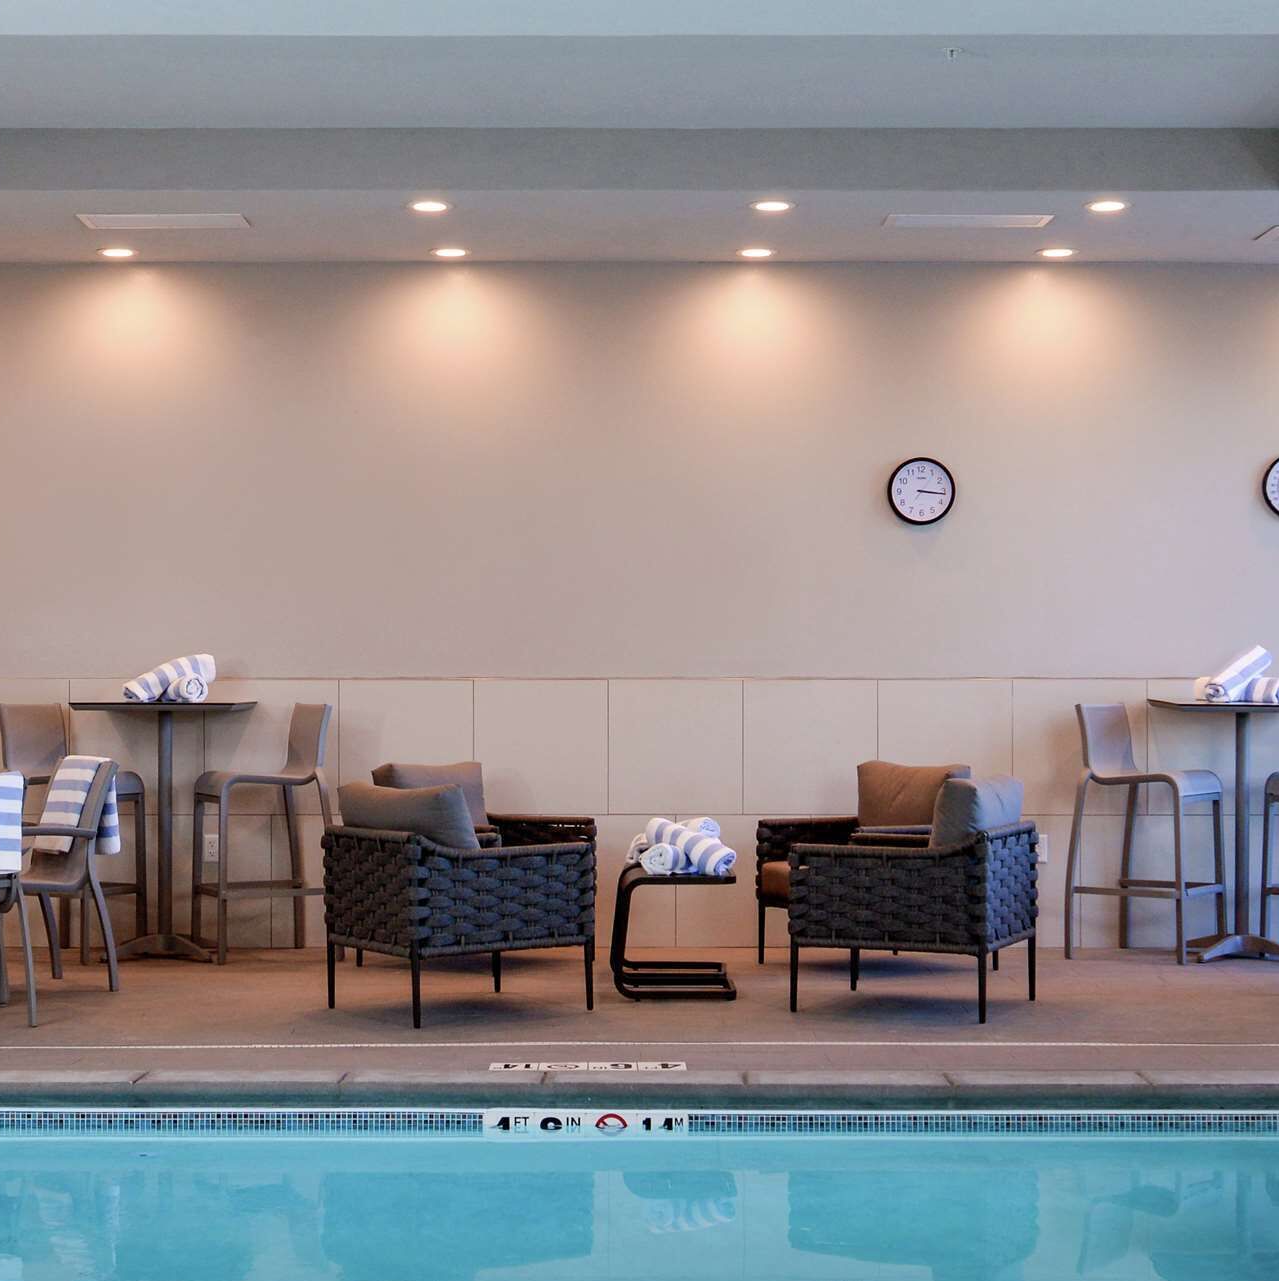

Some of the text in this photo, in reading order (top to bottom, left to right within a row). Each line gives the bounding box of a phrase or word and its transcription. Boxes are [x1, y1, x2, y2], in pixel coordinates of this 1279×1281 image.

[917, 465, 926, 473] 12
[899, 477, 908, 485] 10
[937, 476, 943, 485] 2
[896, 487, 902, 496] 9
[900, 498, 906, 506] 8
[909, 506, 914, 514] 7
[919, 509, 925, 517] 6
[929, 506, 936, 514] 5
